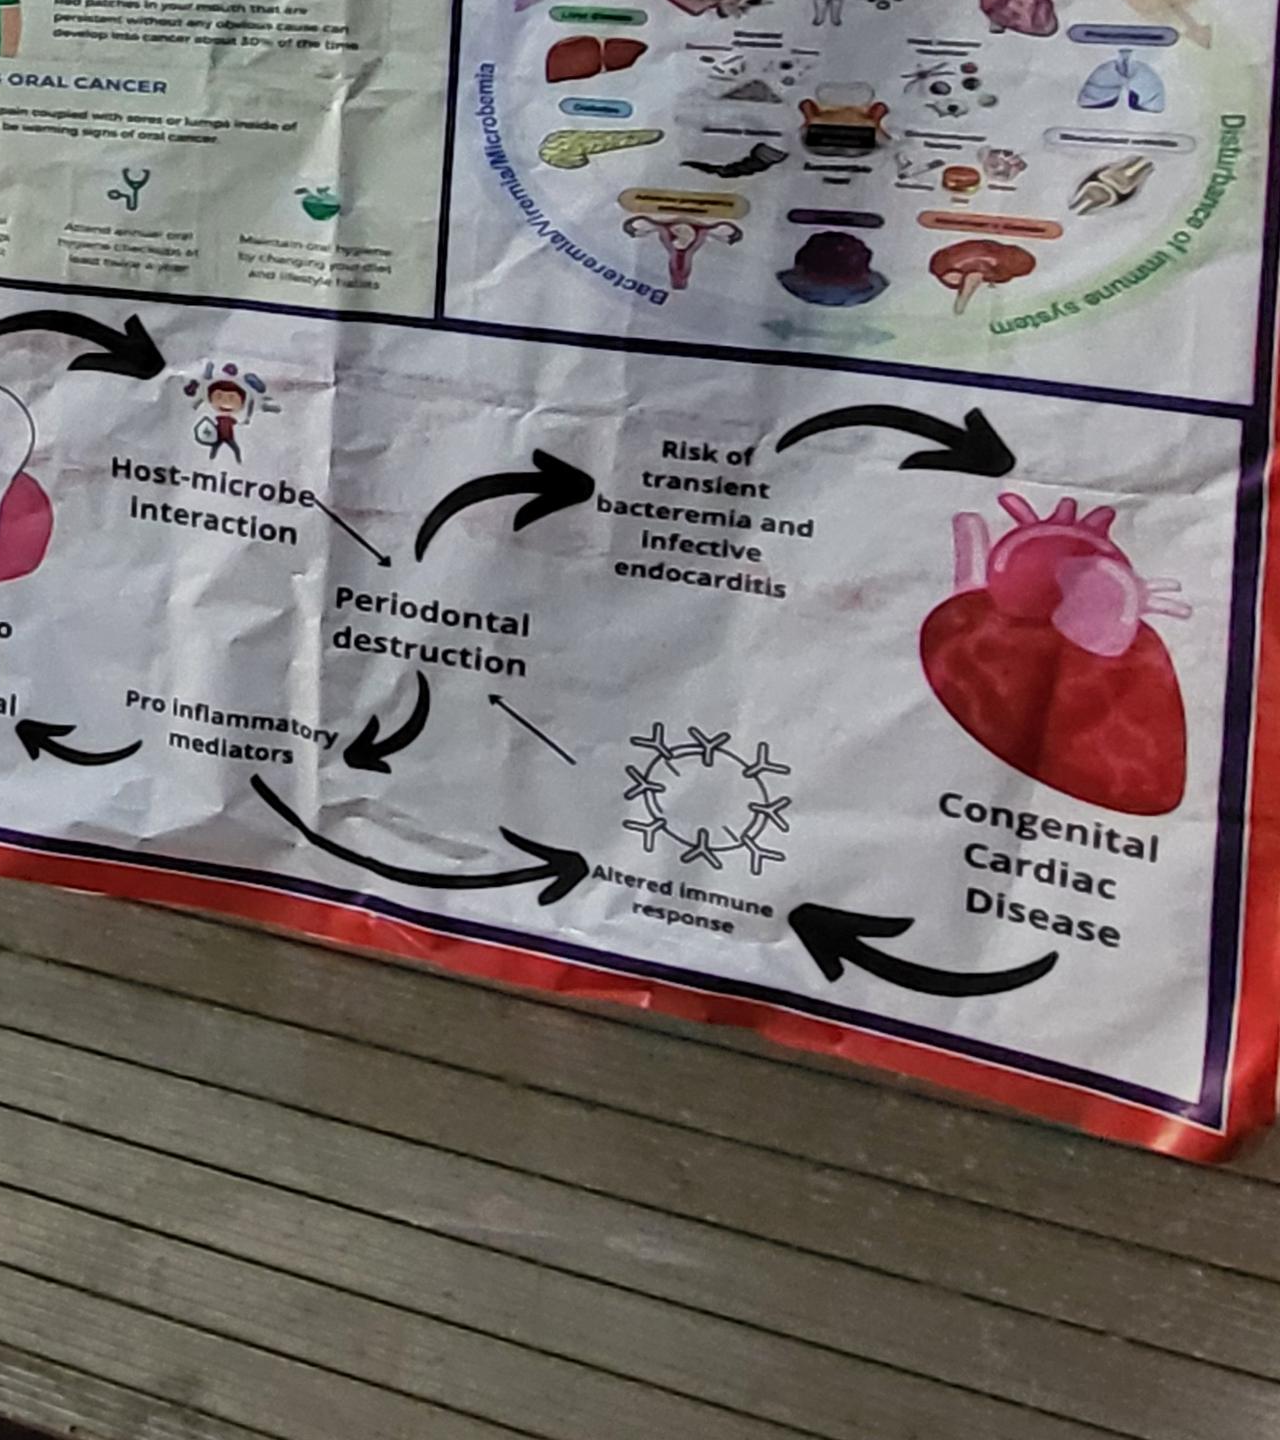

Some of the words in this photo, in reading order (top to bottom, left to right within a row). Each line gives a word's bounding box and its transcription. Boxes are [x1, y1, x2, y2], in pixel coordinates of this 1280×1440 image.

[7, 72, 70, 91] ORAL
[74, 74, 168, 95] CANCER
[661, 440, 718, 467] Risk
[725, 443, 756, 468] of
[110, 456, 317, 509] Host-microbe
[641, 469, 771, 502] transient
[129, 496, 299, 546] interaction
[596, 492, 754, 531] bacteremia
[760, 514, 814, 540] and
[640, 530, 763, 563] infective
[613, 557, 788, 601] endocarditis
[334, 585, 530, 639] Periodontal
[332, 624, 528, 678] destruction
[125, 688, 166, 715] Pro
[172, 697, 339, 750] inflammatory
[168, 728, 295, 766] mediators
[939, 792, 1161, 864] Congenital
[591, 863, 673, 900] Altered
[678, 880, 774, 920] immune
[963, 842, 1118, 902] Cardiac
[632, 898, 735, 936] response
[964, 888, 1123, 949] Disease
